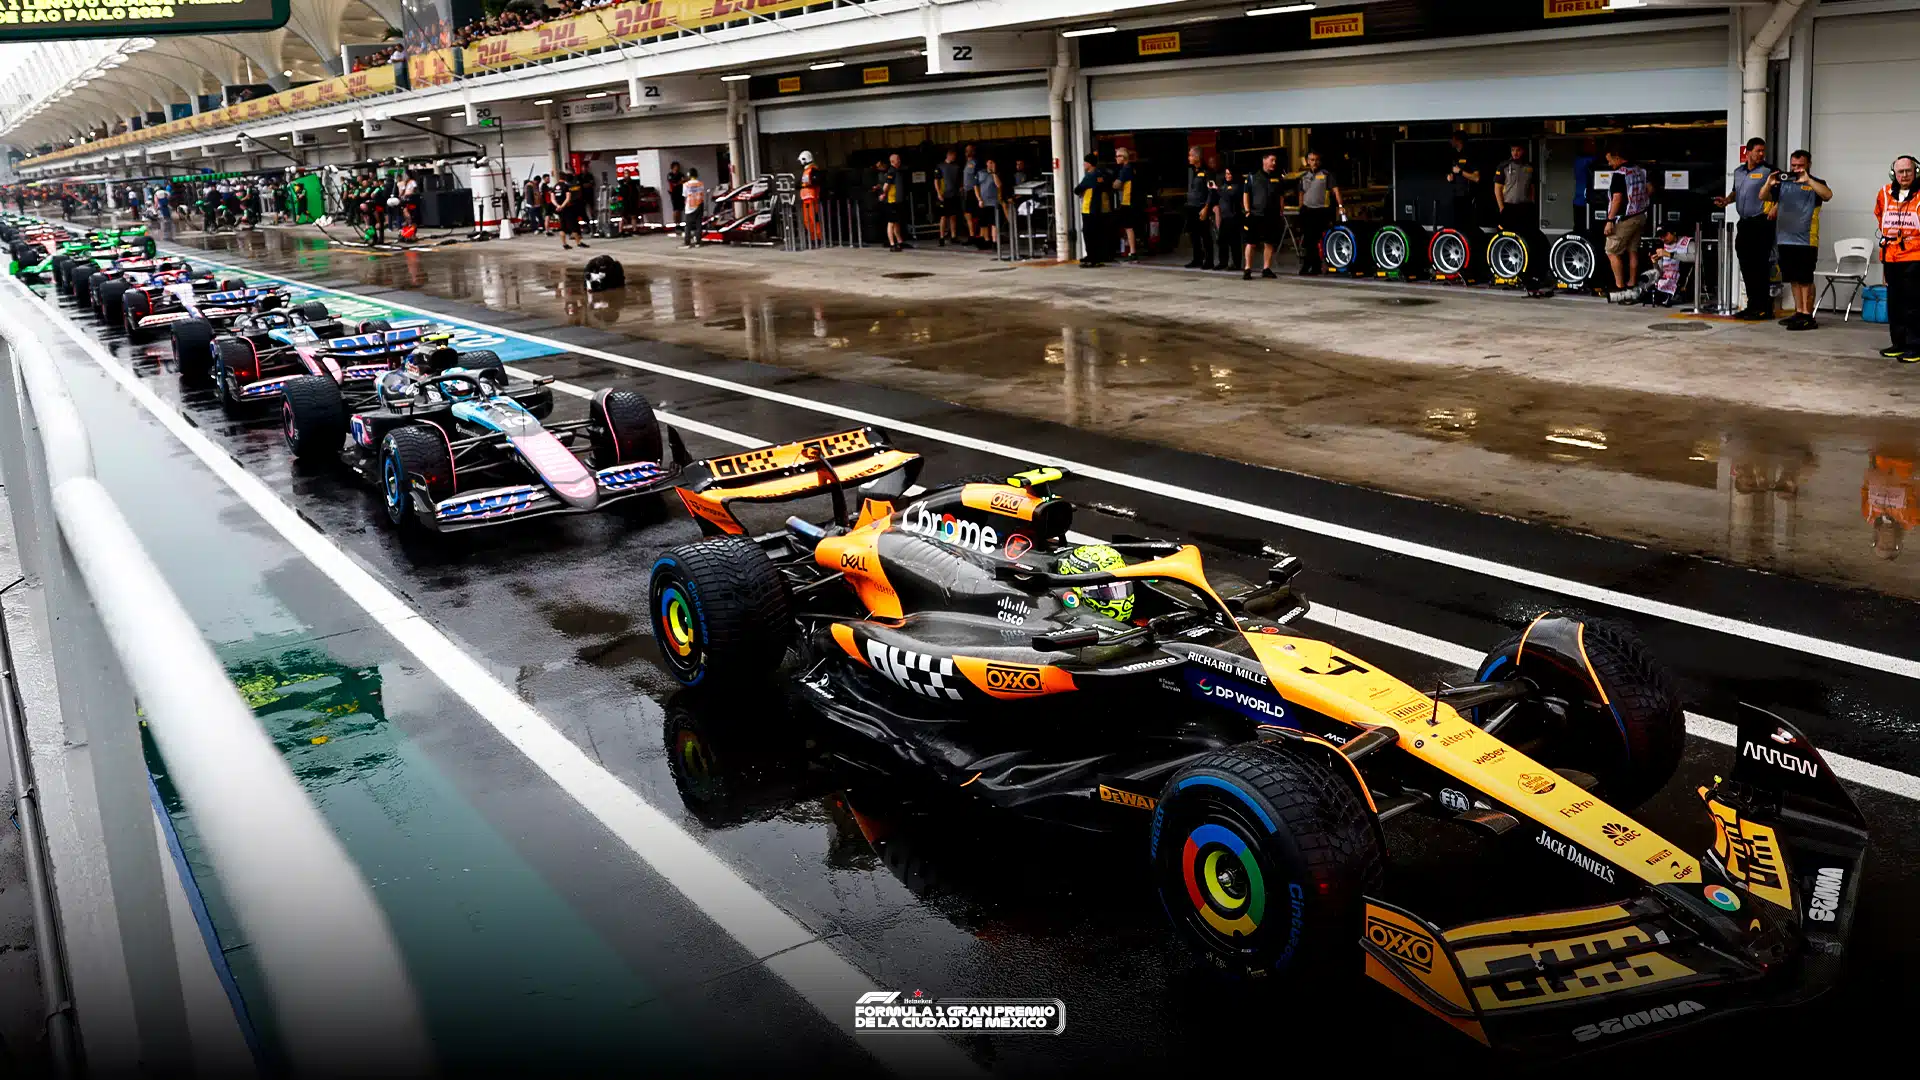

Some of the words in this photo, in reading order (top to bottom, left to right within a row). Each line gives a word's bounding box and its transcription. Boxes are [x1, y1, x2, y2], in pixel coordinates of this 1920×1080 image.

[24, 0, 100, 10] LENOVO
[64, 8, 125, 21] PAULO
[128, 6, 174, 18] 2024
[613, 1, 670, 37] DHL
[1315, 17, 1359, 34] PIRELLI
[537, 21, 588, 53] DHL
[1141, 35, 1177, 51] PIRELLI
[476, 39, 514, 66] DHL
[952, 46, 973, 61] 22
[644, 86, 661, 97] 21
[476, 108, 491, 118] 20
[991, 492, 1023, 510] OXXO
[901, 500, 998, 554] Chrome
[840, 552, 869, 573] DELL
[1123, 656, 1177, 672] vmware
[1187, 651, 1233, 673] RICHARD
[1235, 667, 1268, 686] MILLE
[987, 668, 1042, 691] OXXO
[1215, 685, 1234, 699] DP
[1235, 691, 1285, 718] WORLD
[1393, 702, 1428, 718] Hilton
[1440, 727, 1477, 748] alteryx
[1473, 747, 1508, 766] webex
[1743, 741, 1818, 778] ARROW
[1440, 790, 1468, 809] FIA
[1560, 799, 1594, 819] FxPro
[1613, 828, 1642, 847] CNBC
[1646, 849, 1673, 865] PIRELLI
[1808, 867, 1845, 922] SENNA
[1368, 924, 1434, 965] OXXO
[1571, 1000, 1706, 1043] SENNA
